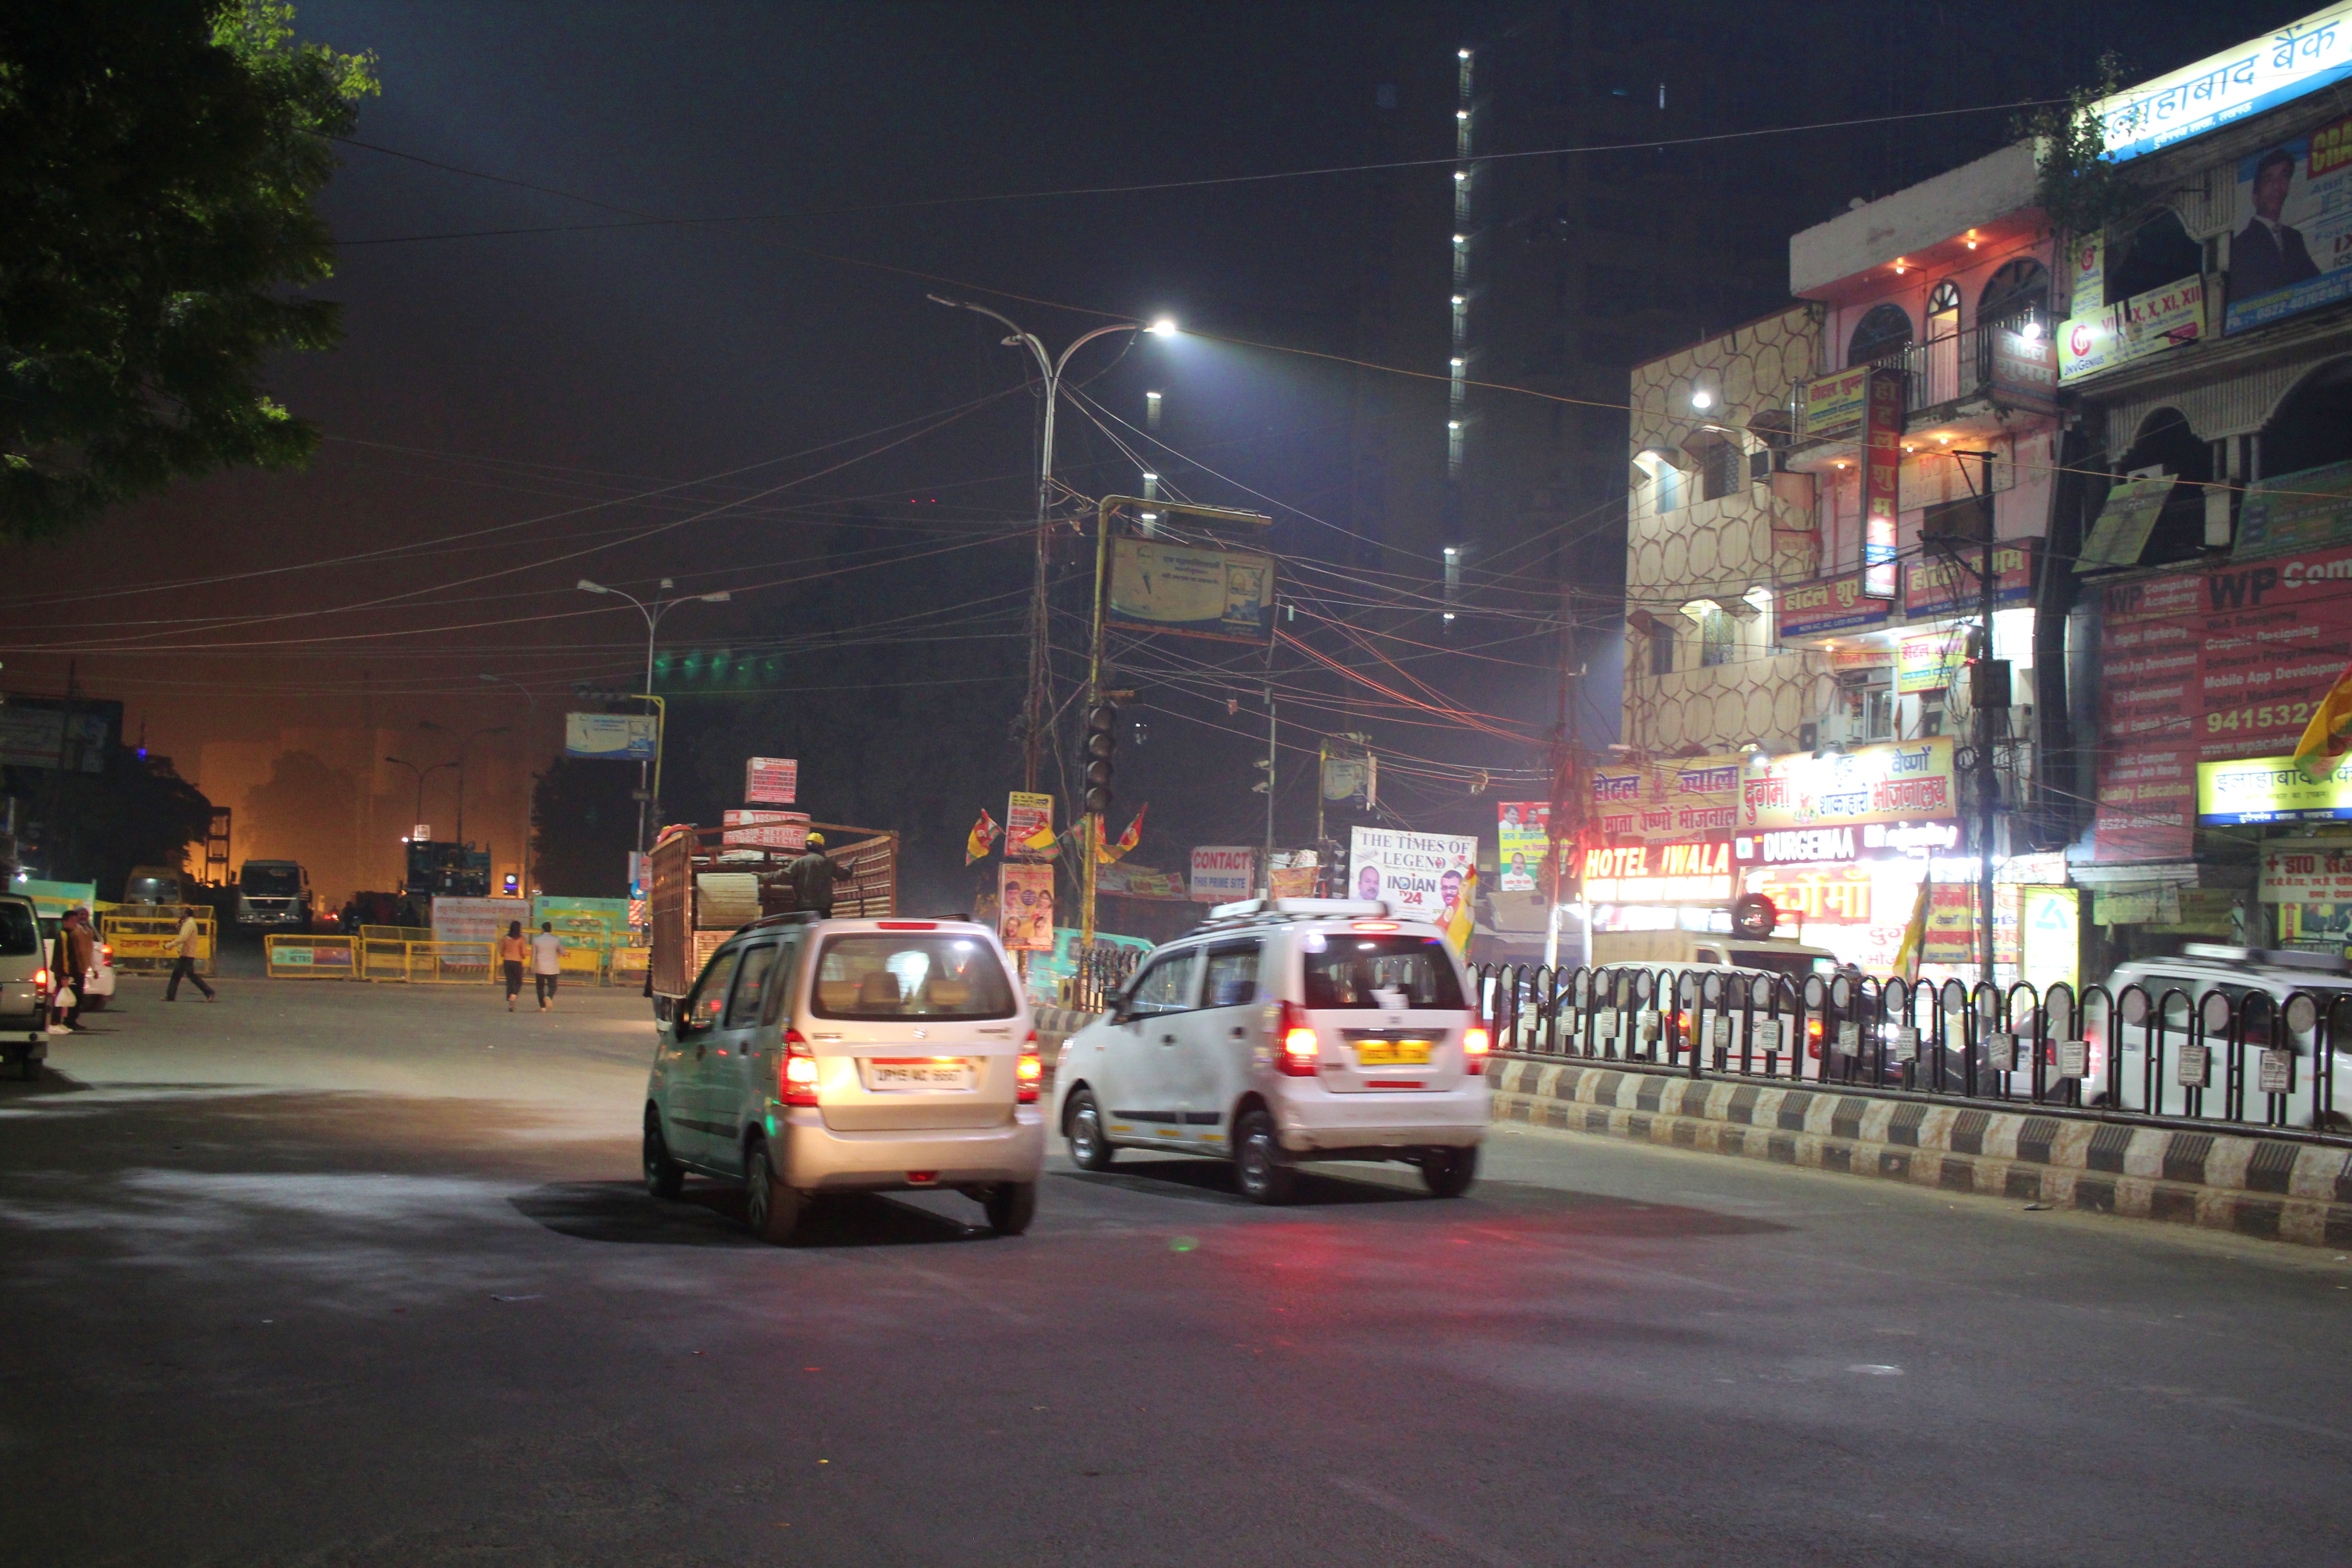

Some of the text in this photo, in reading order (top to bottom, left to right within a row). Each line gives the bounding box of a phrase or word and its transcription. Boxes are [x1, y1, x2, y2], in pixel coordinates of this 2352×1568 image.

[2102, 20, 2340, 135] लाहाबाद बैंक
[1784, 585, 1829, 611] होटल
[2209, 566, 2278, 611] WP
[2204, 673, 2244, 690] Mobile
[2247, 670, 2272, 684] App
[1591, 765, 1740, 802] होटल ज्वाला
[1820, 772, 1948, 815] शाकाहारी भोजनालय
[2137, 782, 2190, 799] Education
[1603, 813, 1634, 834] माता
[1361, 833, 1470, 854] THE TIMES OF
[1194, 852, 1249, 870] CONTACT
[1383, 852, 1446, 870] LEGEND
[1585, 846, 1648, 877] HOTEL
[1230, 877, 1245, 889] SITE
[1387, 872, 1436, 892] INDIAN
